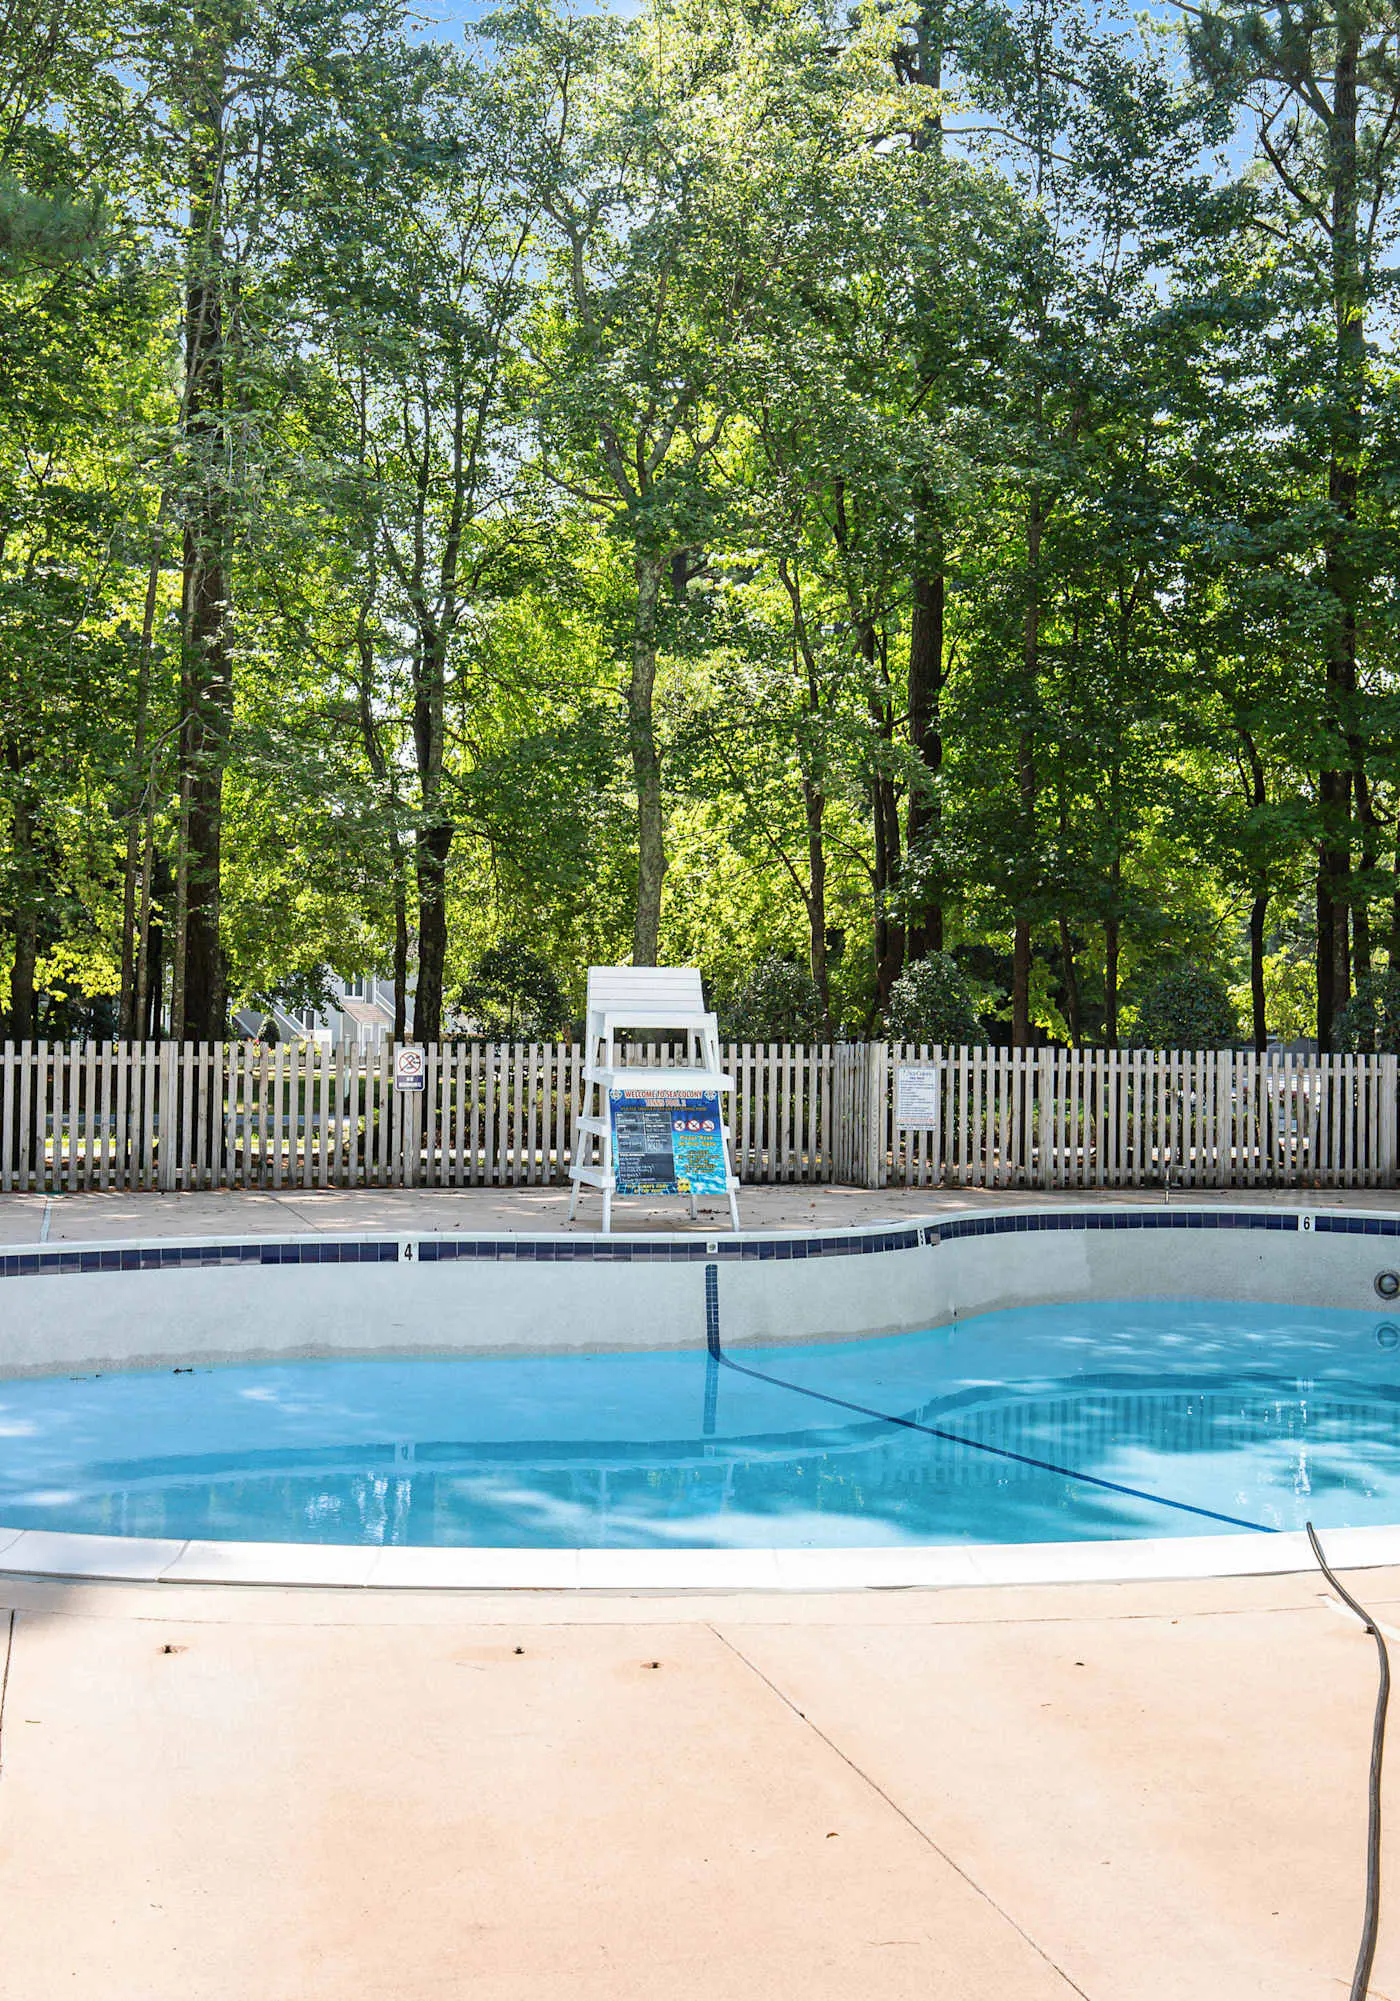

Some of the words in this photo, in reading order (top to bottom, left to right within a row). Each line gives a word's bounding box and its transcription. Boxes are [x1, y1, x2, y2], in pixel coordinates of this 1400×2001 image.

[625, 1090, 654, 1098] WELCOME
[656, 1090, 665, 1098] TO
[666, 1090, 677, 1098] SEA
[679, 1090, 702, 1099] COLONY
[1303, 1216, 1310, 1230] 6
[404, 1243, 413, 1261] 4
